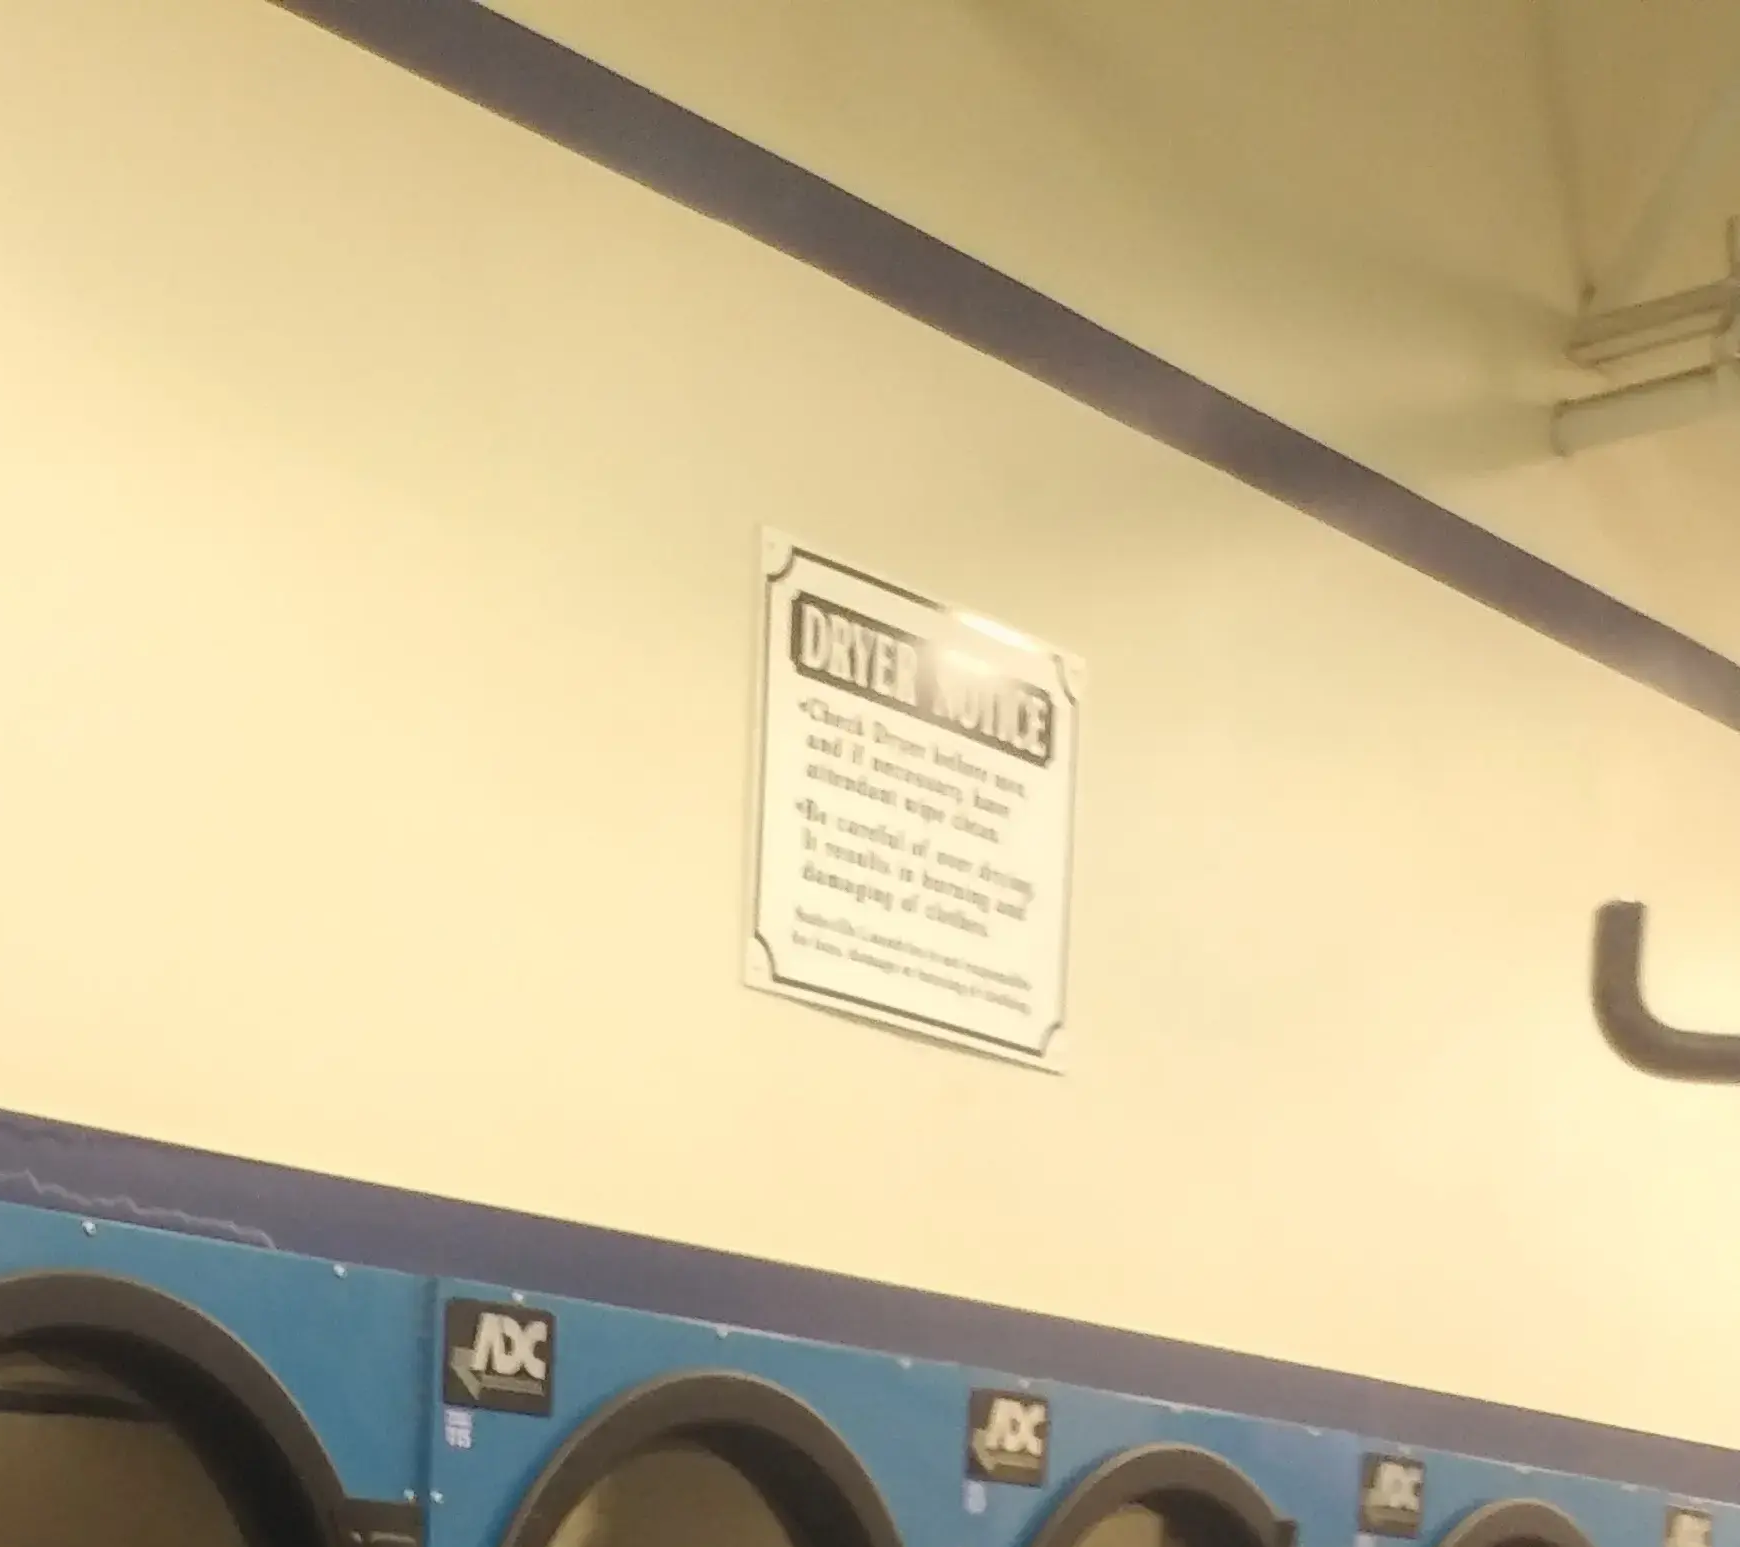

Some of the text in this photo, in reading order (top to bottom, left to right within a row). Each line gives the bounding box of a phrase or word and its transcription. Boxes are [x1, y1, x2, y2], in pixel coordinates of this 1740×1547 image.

[802, 604, 918, 708] DRYER
[474, 1312, 548, 1380] ADC
[985, 1398, 1046, 1456] ADC
